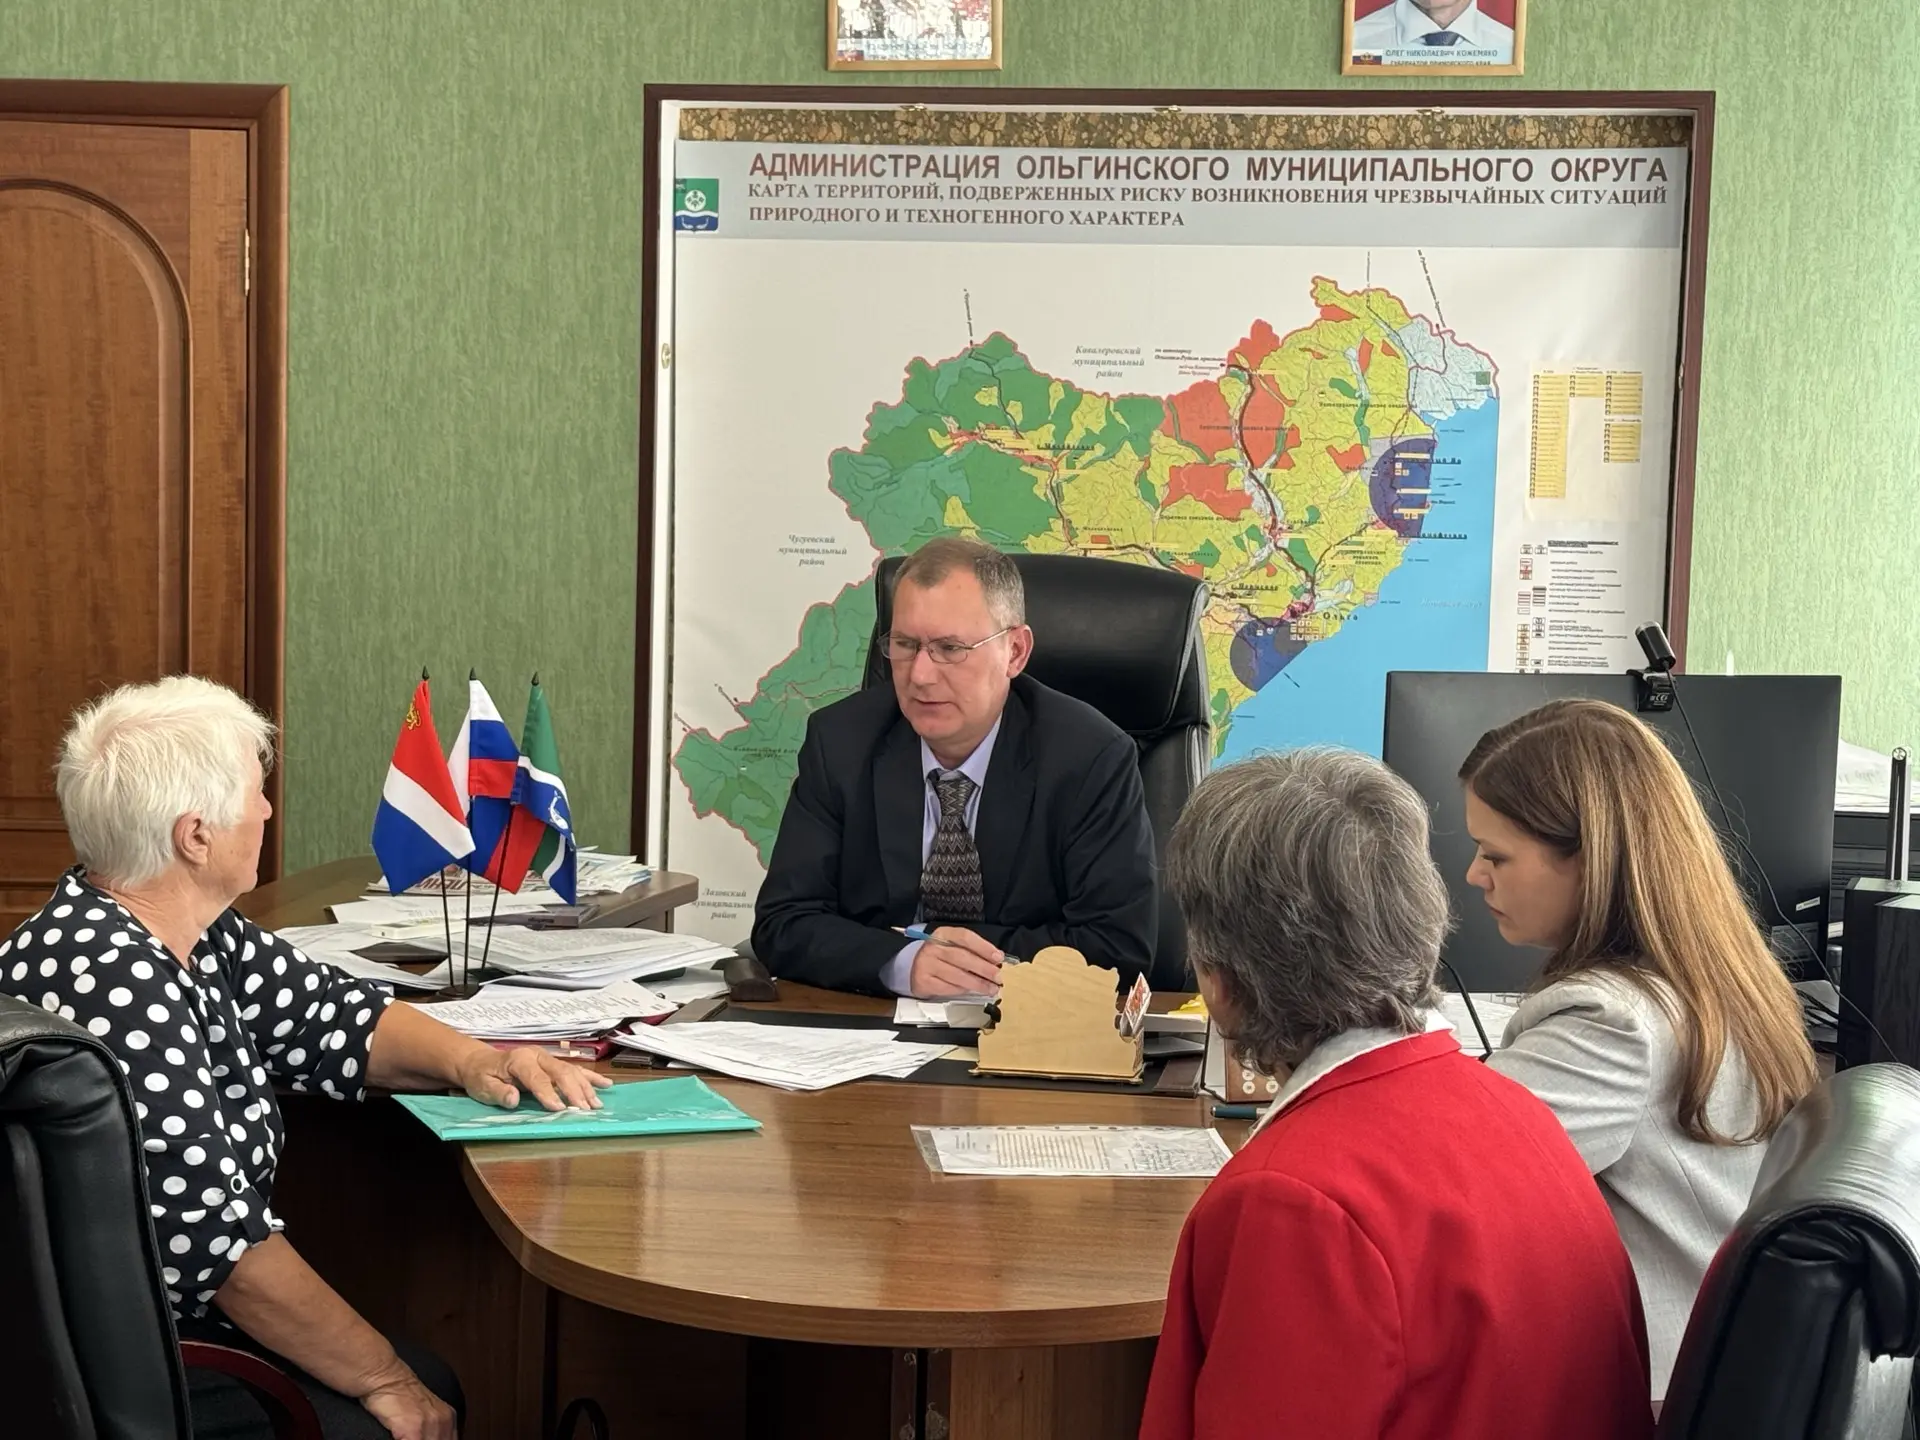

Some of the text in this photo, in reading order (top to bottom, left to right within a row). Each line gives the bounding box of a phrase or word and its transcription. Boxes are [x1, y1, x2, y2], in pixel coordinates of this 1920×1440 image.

[749, 153, 1668, 186] АДМИНИСТРАЦИЯ ОЛЬГИНСКОГО МУНИЦИПАЛЬНОГО ОКРУГА
[748, 182, 1668, 207] КАРТА ТЕРРИТОРИЙ, ПОДВЕРЖЕННЫХ РИСКУ ВОЗНИКНОВЕНИЯ ЧРЕЗВЫЧАЙНЫХ СИТУАЦИЙ
[749, 207, 1185, 226] ПРИРОДНОГО И ТЕХНОГЕННОГО ХАРАКТЕРА
[1075, 345, 1141, 356] Кавалеровский
[1072, 358, 1145, 367] муниципальный
[1095, 370, 1123, 379] район
[777, 546, 847, 556] муниципальный
[798, 557, 825, 567] район
[692, 900, 753, 909] униципальны
[710, 911, 737, 920] район
